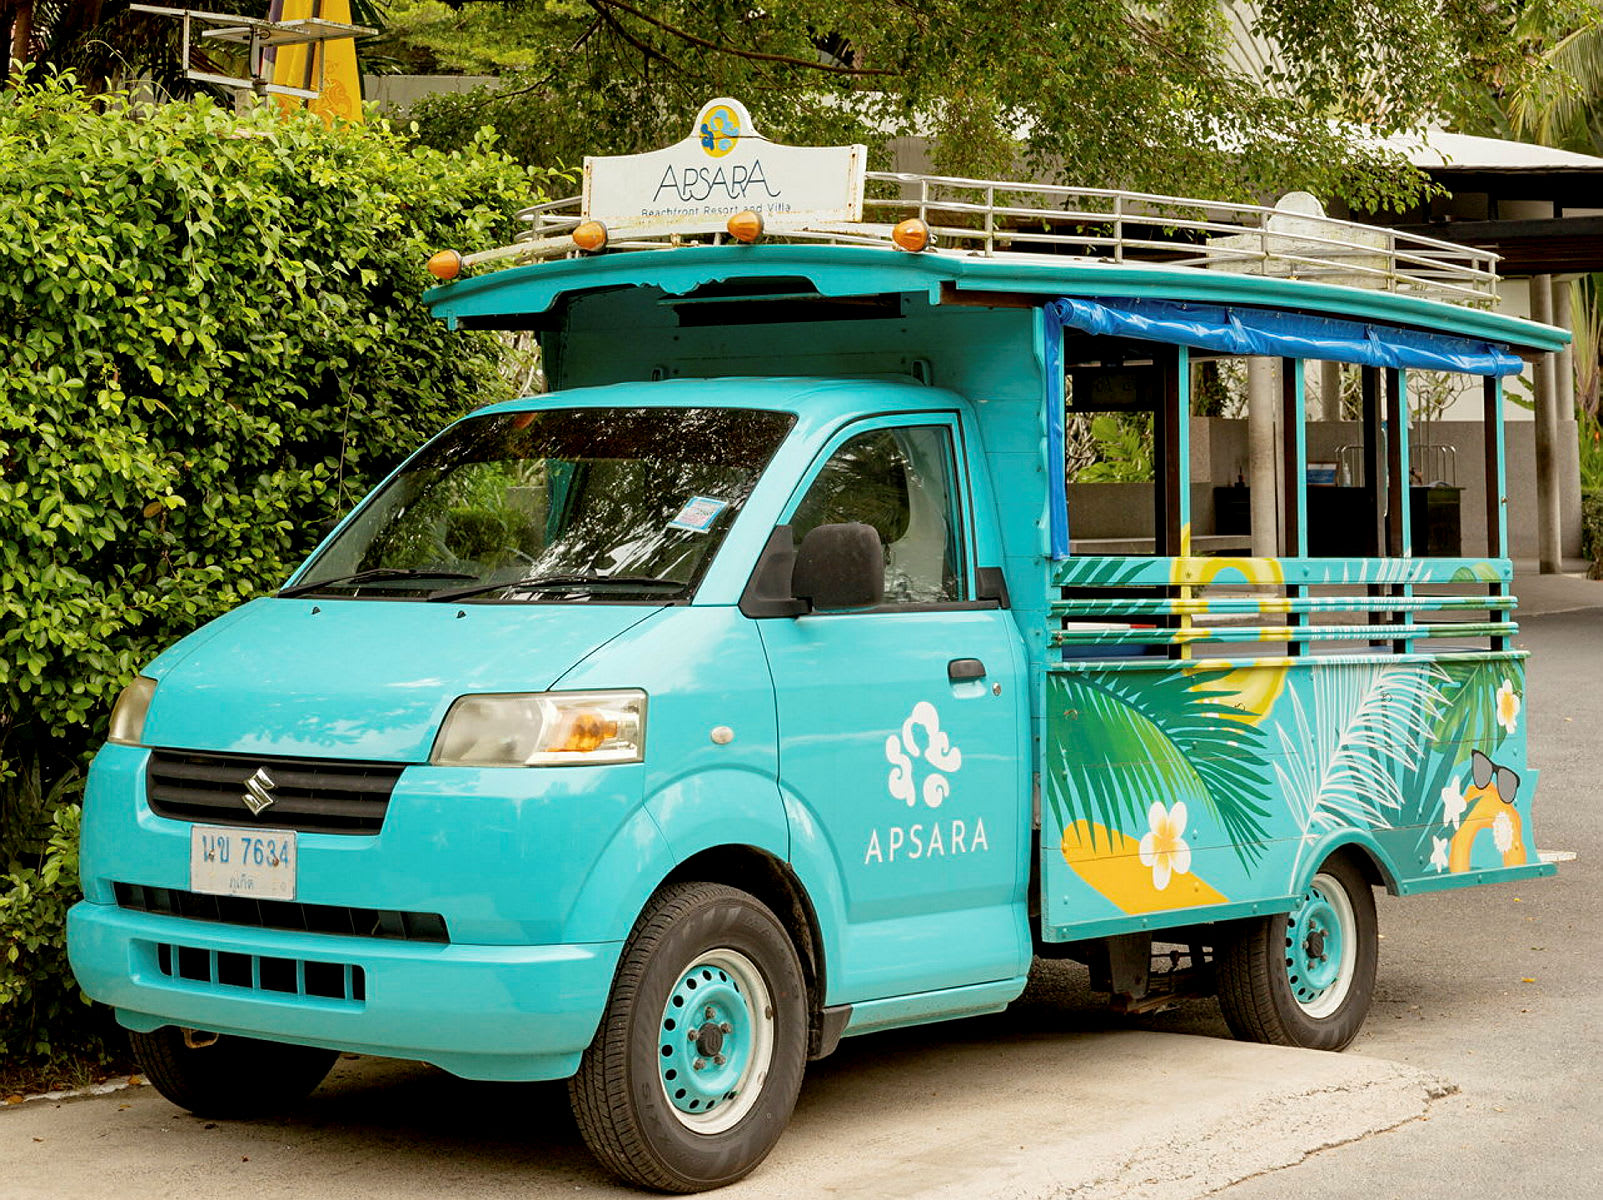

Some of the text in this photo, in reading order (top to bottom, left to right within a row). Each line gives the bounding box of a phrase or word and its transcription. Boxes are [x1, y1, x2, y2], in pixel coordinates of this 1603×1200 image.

[652, 159, 782, 202] APSARA
[641, 207, 699, 216] Beachfront
[703, 205, 738, 215] Resort
[767, 202, 792, 213] Villa
[241, 837, 289, 868] 7634
[864, 816, 989, 865] APSARA
